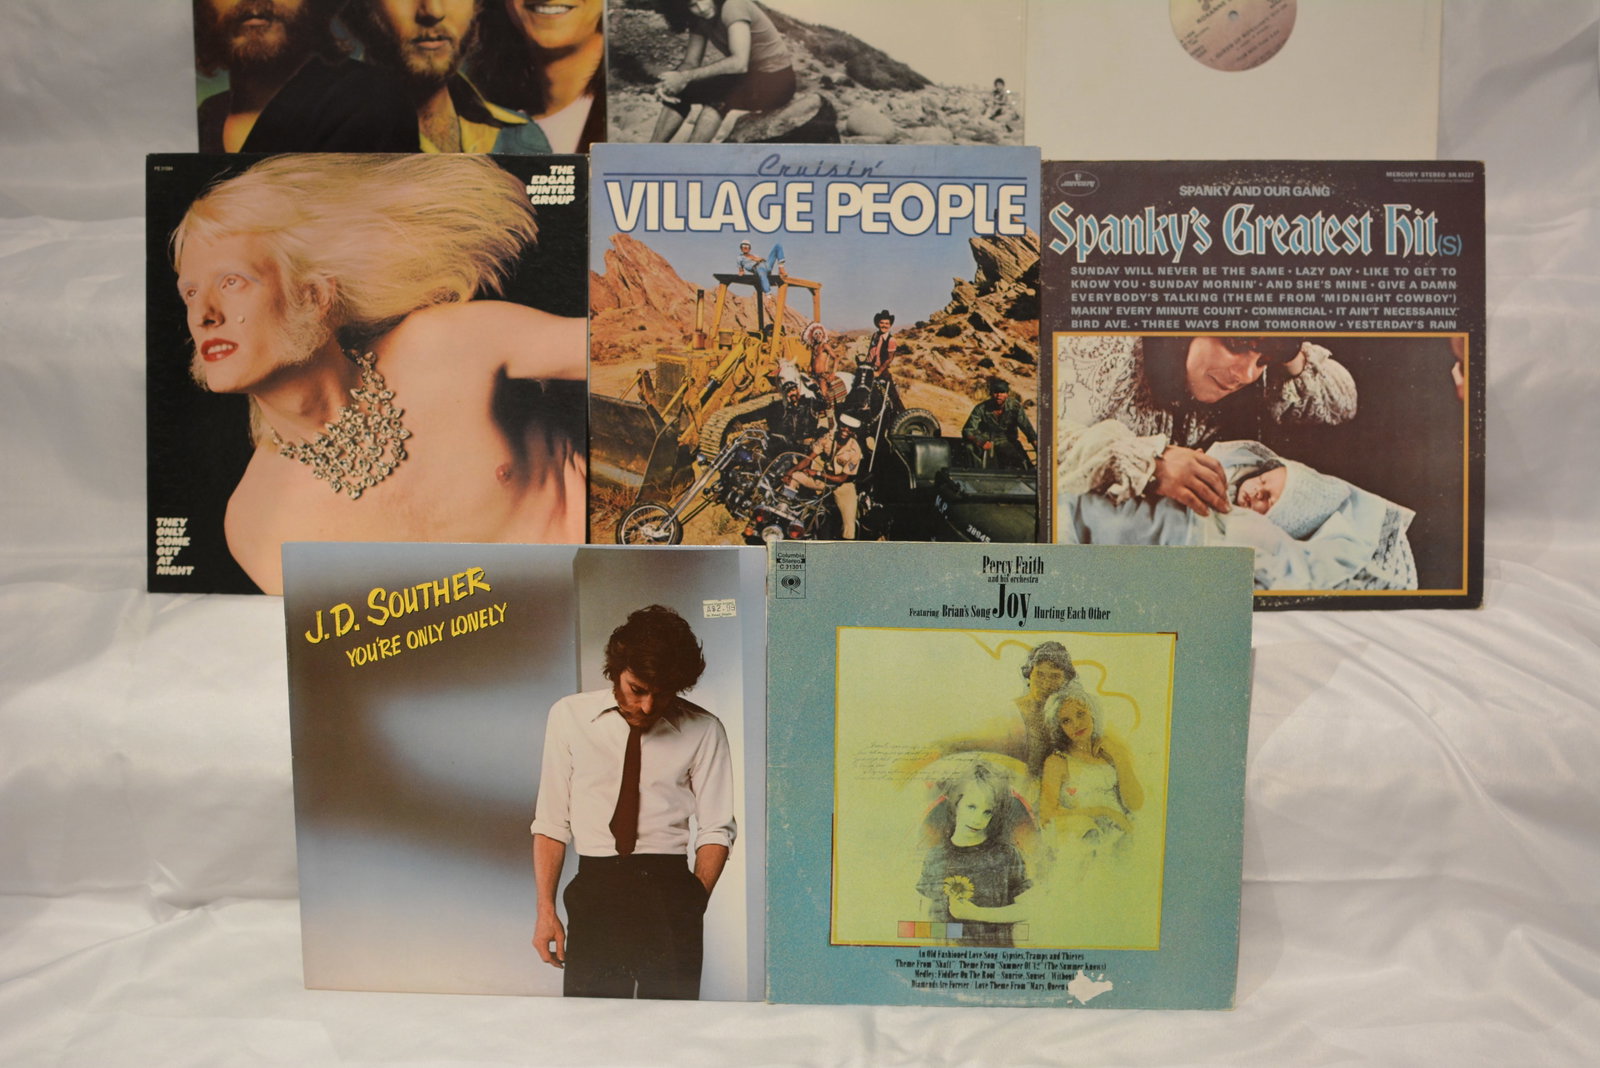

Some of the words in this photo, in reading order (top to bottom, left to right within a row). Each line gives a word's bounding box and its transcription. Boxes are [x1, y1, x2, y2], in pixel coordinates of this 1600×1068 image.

[550, 165, 575, 175] THE
[757, 153, 884, 177] Cruisin'
[531, 175, 575, 185] EDGAR
[526, 185, 575, 195] WINTER
[1179, 185, 1231, 197] SPANKY
[1233, 185, 1261, 197] AND
[1264, 186, 1290, 197] OUR
[1293, 186, 1330, 197] GANG
[531, 195, 575, 205] GROUP
[604, 180, 814, 233] VILLAGE
[825, 181, 1027, 236] PEOPLE
[1048, 201, 1212, 264] Spanky's
[1222, 203, 1373, 256] Greatest
[1070, 266, 1120, 275] SUNDAY
[1124, 267, 1153, 275] WILL
[1158, 267, 1197, 275] NEVER
[1202, 267, 1217, 276] BE
[1222, 267, 1245, 276] THE
[1250, 267, 1284, 276] SAME
[1296, 267, 1324, 276] LAZY
[1330, 267, 1352, 276] DAY
[1363, 267, 1389, 276] LIKE
[1394, 267, 1409, 276] TO
[1414, 267, 1436, 276] GET
[1441, 267, 1456, 276] TO
[1071, 280, 1110, 289] KNOW
[1114, 280, 1139, 289] YOU
[1150, 280, 1198, 289] SUNDAY
[1203, 280, 1256, 289] MORNIN'
[1266, 280, 1292, 289] AND
[1296, 280, 1331, 289] SHE'S
[1336, 280, 1367, 289] MINE
[1378, 280, 1405, 289] GIVE
[1409, 280, 1417, 289] A
[1421, 280, 1456, 289] DAMN
[1071, 293, 1158, 302] EVERYBODY'S
[1164, 293, 1218, 302] TALKING
[1223, 293, 1273, 302] (THEME
[1280, 293, 1315, 302] FROM
[1071, 306, 1113, 315] MAKIN'
[1116, 306, 1152, 315] EVERY
[1156, 307, 1199, 315] MINUTE
[1203, 307, 1242, 316] COUNT
[1251, 307, 1327, 316] COMMERCIAL
[1336, 307, 1346, 316] IT
[1349, 307, 1379, 316] AIN'T
[1071, 320, 1099, 328] BIRD
[1104, 320, 1130, 329] AVE.
[1141, 320, 1180, 329] THREE
[1185, 320, 1219, 329] WAYS
[1225, 320, 1259, 329] FROM
[1264, 320, 1336, 329] TOMORROW
[1347, 320, 1424, 329] YESTERDAY'S
[1430, 320, 1456, 329] RAIN
[156, 517, 188, 527] THEY
[156, 527, 186, 536] ONLY
[156, 537, 190, 546] COME
[156, 547, 181, 556] OUT
[156, 556, 173, 565] AT
[982, 555, 1014, 576] Percy
[1015, 556, 1044, 574] Faith
[156, 566, 194, 576] NIGHT
[988, 575, 999, 583] and
[1000, 574, 1009, 583] his
[1010, 575, 1039, 583] orchestra
[992, 583, 1031, 627] Joy
[909, 608, 939, 618] Featuring
[942, 604, 969, 617] Brian's
[971, 605, 991, 620] Song
[1034, 606, 1066, 622] Hurting
[1067, 607, 1086, 620] Each
[1088, 607, 1111, 620] Other
[346, 635, 402, 667] YOU'RE
[406, 622, 445, 649] ONLY
[450, 602, 508, 637] LONELY
[938, 950, 967, 958] Fashioned
[984, 951, 998, 960] Song
[1050, 952, 1060, 960] and
[896, 959, 915, 968] Theme
[917, 960, 932, 968] From
[959, 960, 978, 968] Theme
[980, 961, 995, 969] From
[970, 971, 980, 979] The
[982, 971, 995, 979] Roof
[975, 981, 988, 989] Love
[990, 981, 1009, 989] Theme
[1011, 982, 1026, 990] From
